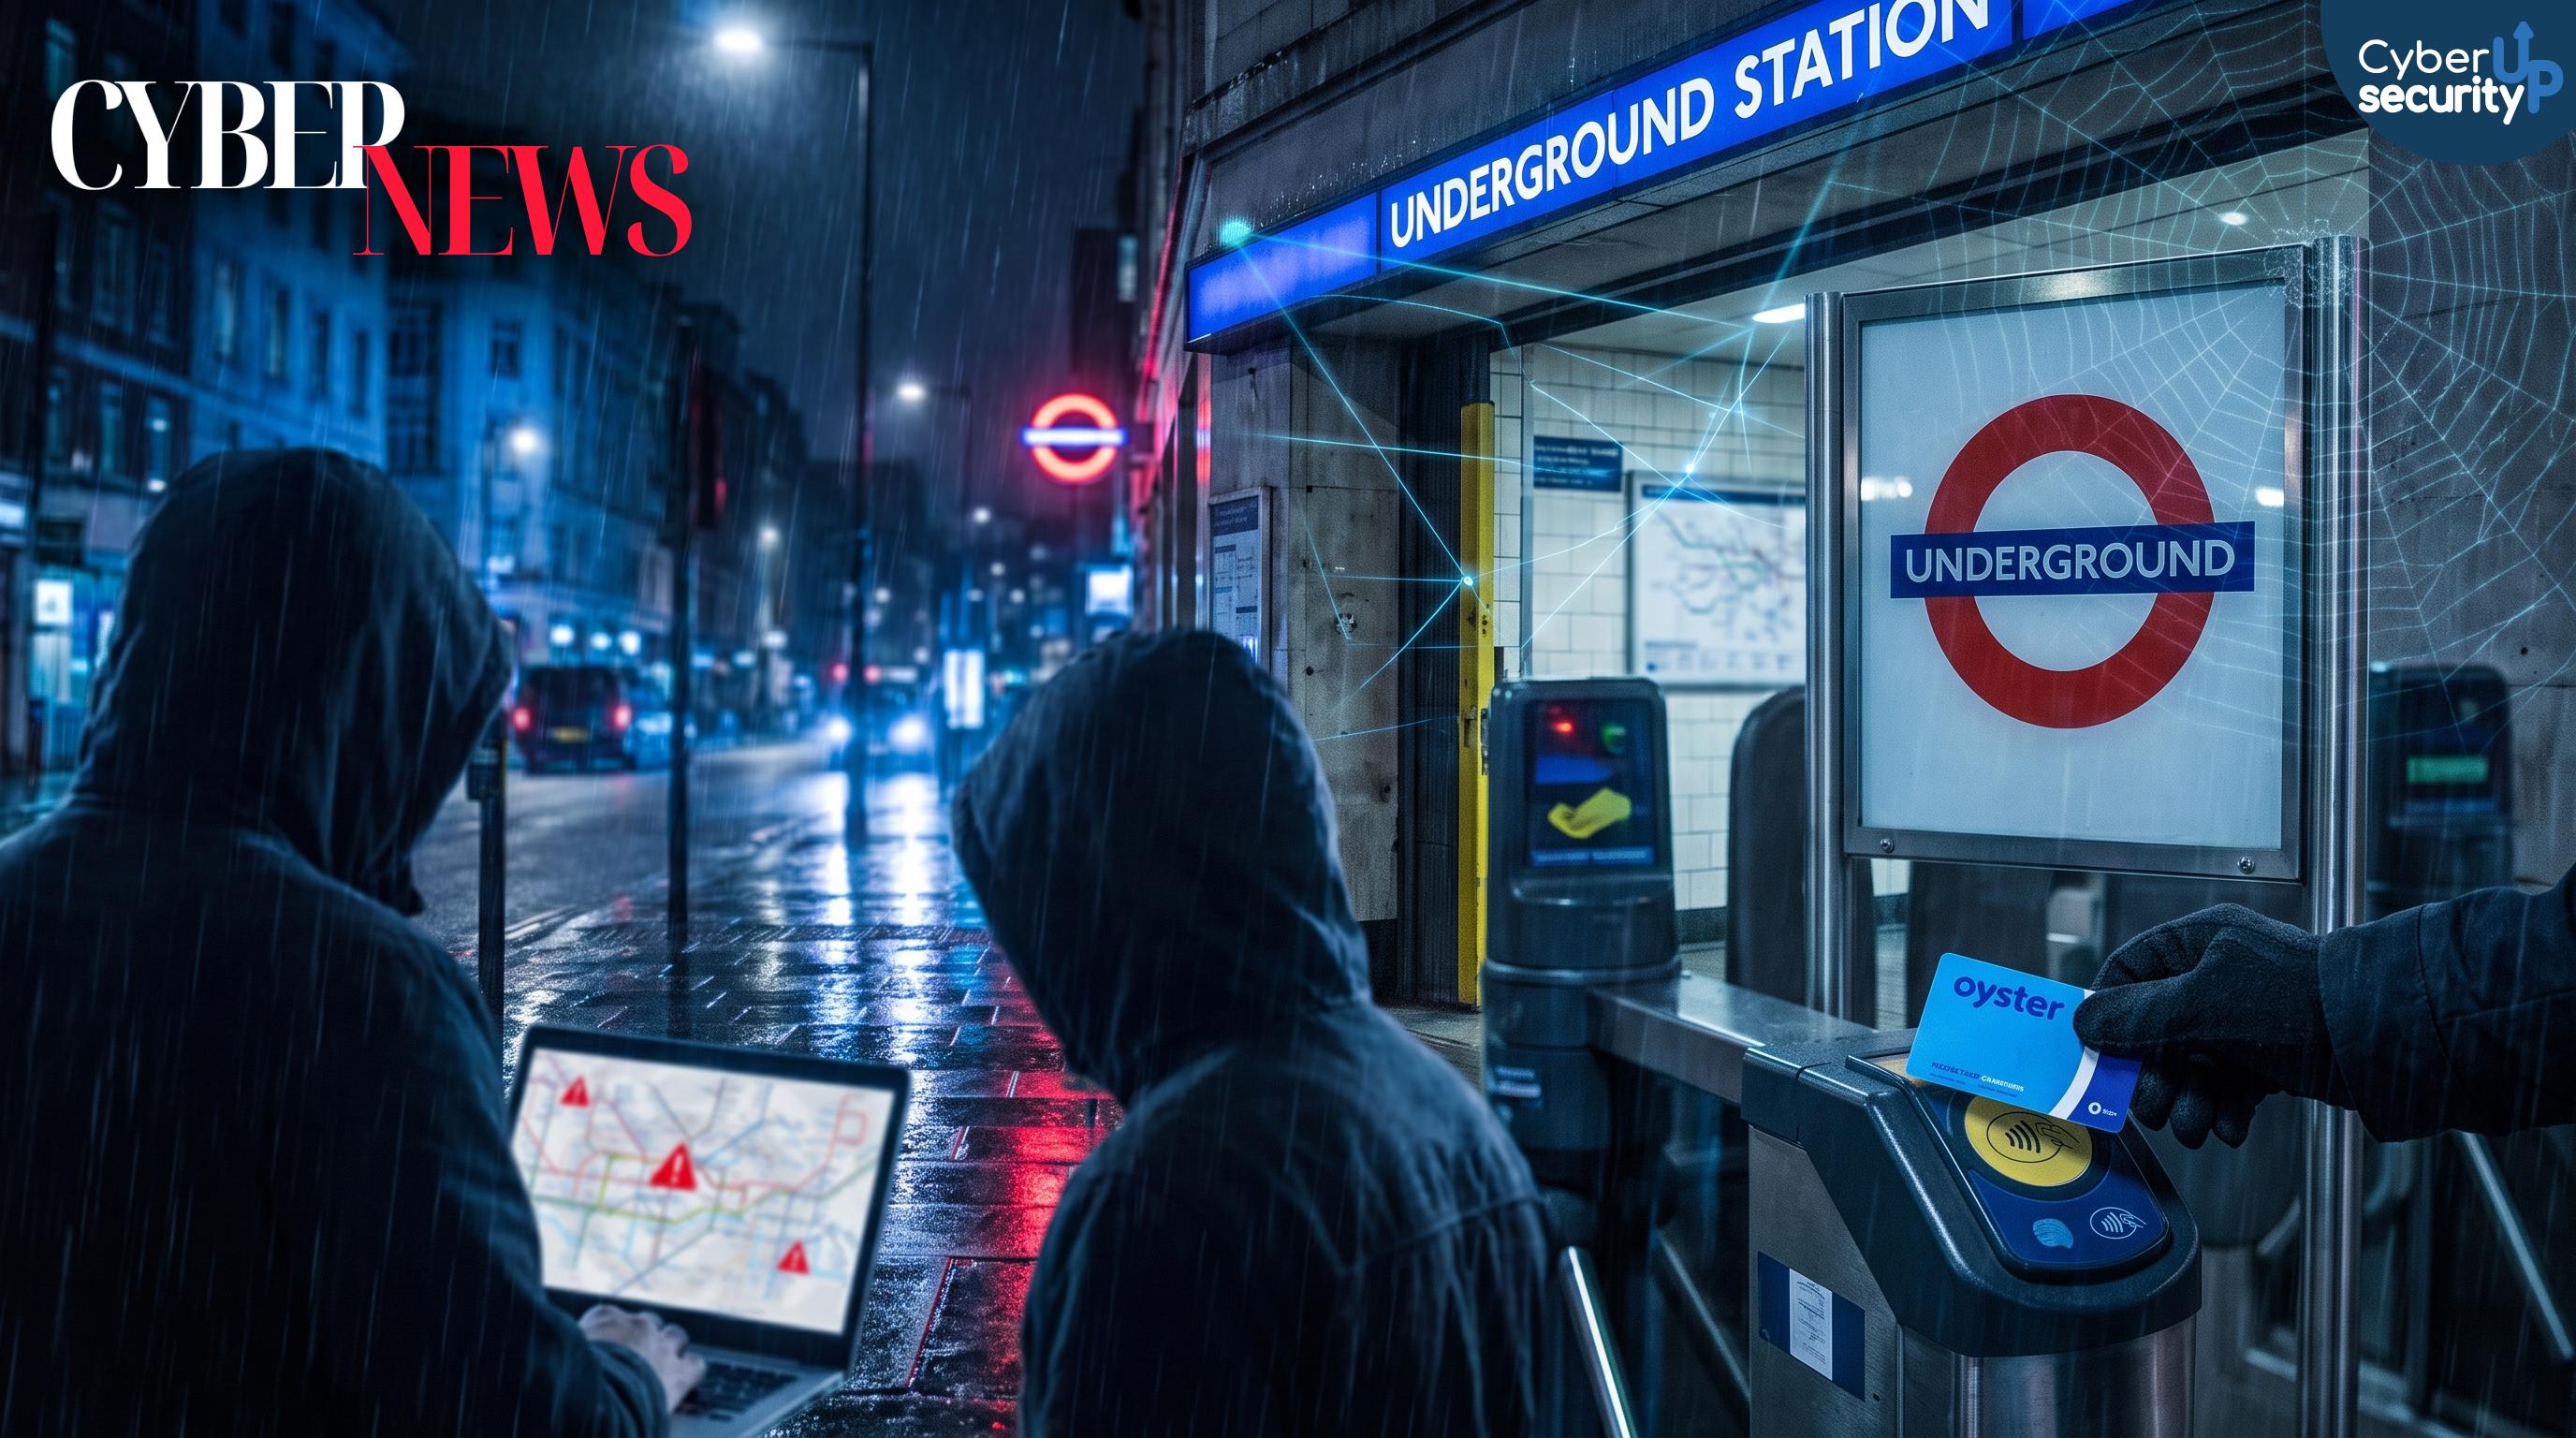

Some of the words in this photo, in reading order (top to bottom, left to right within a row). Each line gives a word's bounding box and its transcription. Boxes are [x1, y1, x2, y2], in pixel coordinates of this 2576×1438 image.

[1391, 78, 1715, 248] UNDERGROUND
[1734, 0, 1990, 119] STATION
[1906, 539, 2235, 583] UNDERGROUND
[1953, 976, 2066, 1020] oyster
